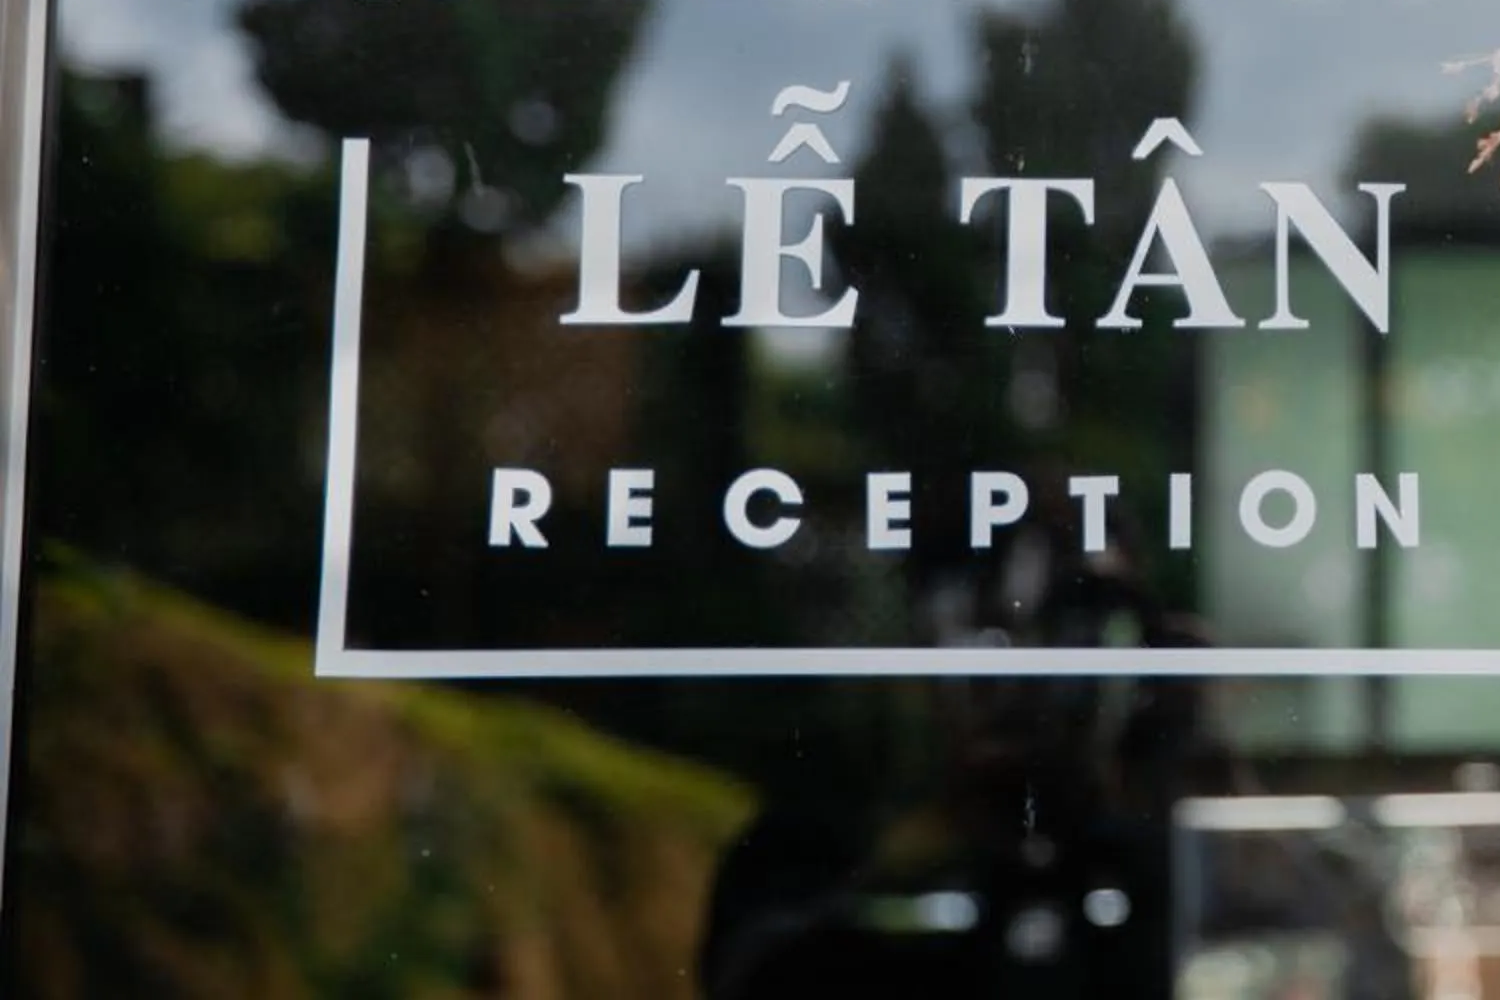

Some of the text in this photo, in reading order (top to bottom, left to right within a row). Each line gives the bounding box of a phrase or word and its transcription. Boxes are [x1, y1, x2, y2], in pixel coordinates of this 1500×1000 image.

[559, 80, 1408, 334] LỄ TÂN
[488, 466, 1421, 552] RECEPTION
